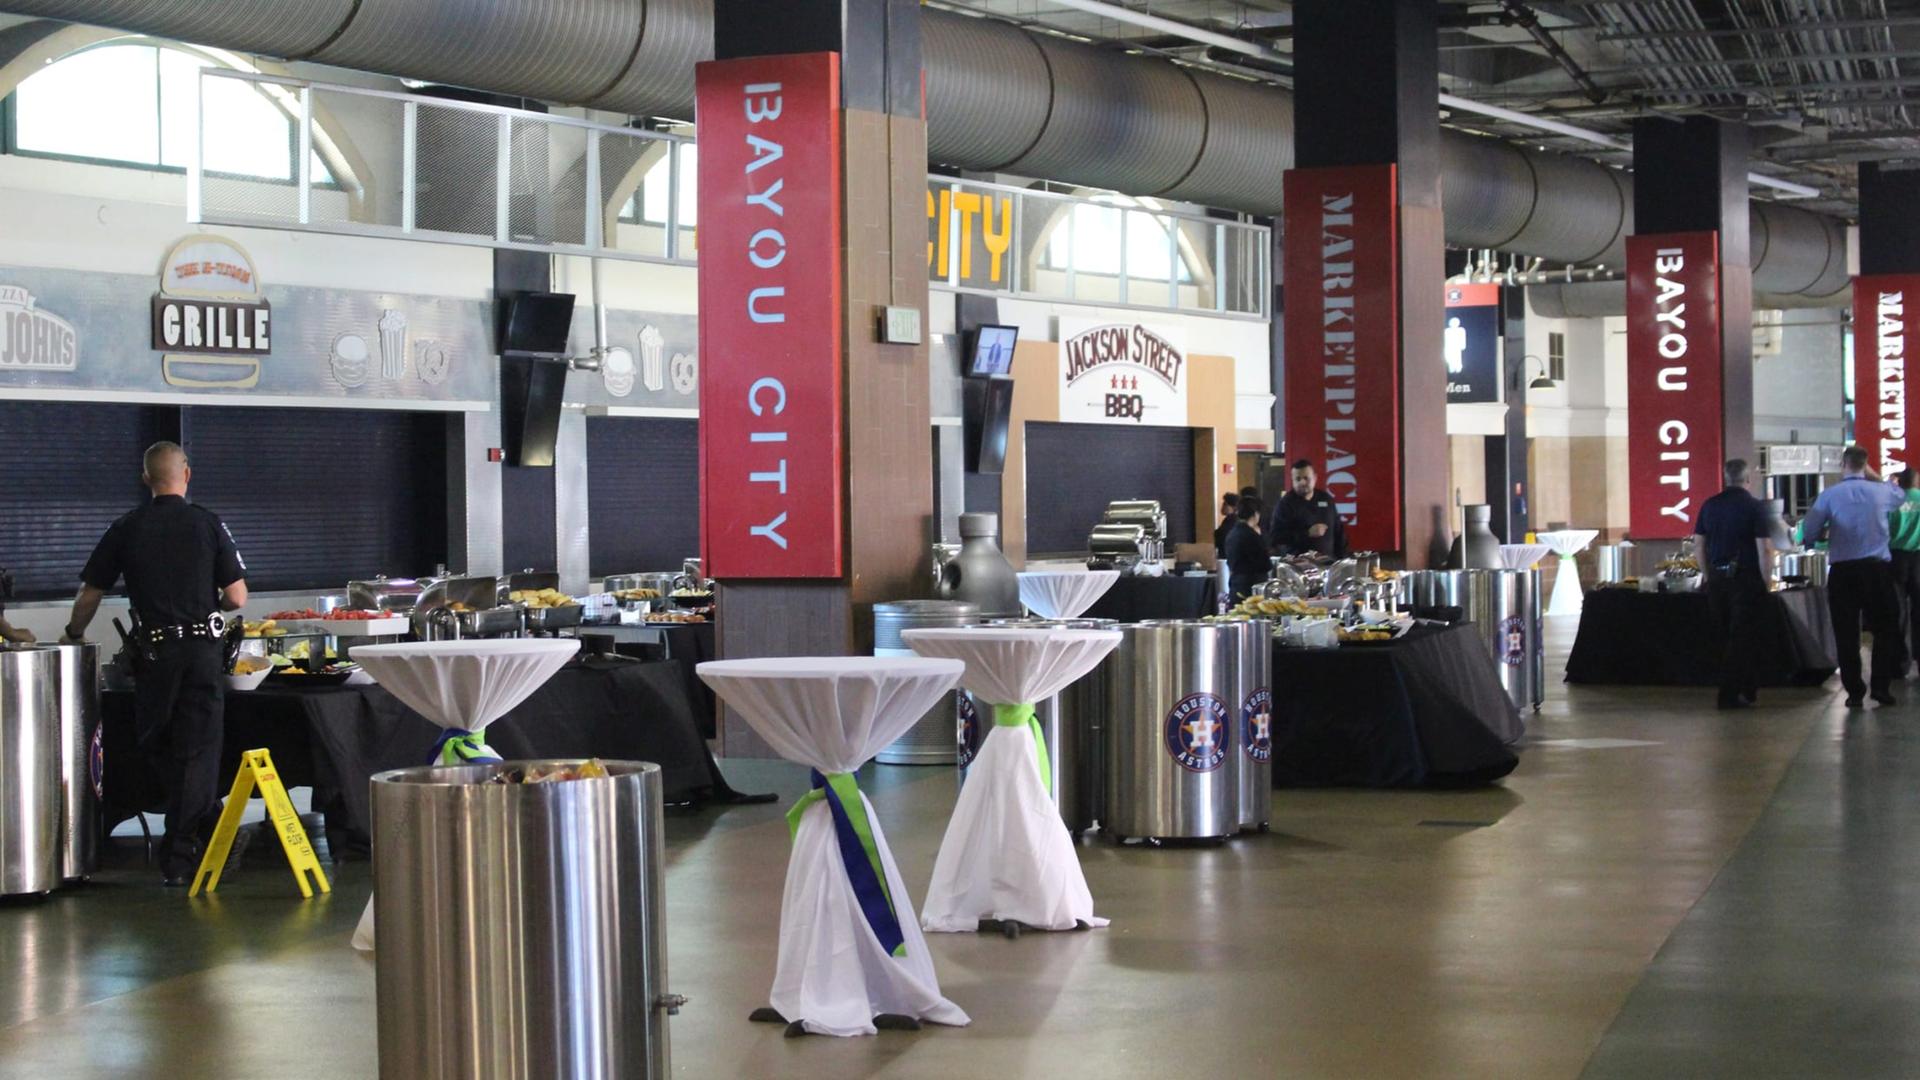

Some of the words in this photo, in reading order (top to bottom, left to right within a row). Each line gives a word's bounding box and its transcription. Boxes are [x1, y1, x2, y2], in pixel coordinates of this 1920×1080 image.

[743, 82, 787, 324] BAYOU
[1, 311, 74, 366] JOHNS
[162, 304, 270, 350] GRILLE
[1655, 247, 1688, 393] BAYOU
[1065, 327, 1129, 382] JACKSON
[1132, 323, 1183, 387] STREET
[1322, 193, 1358, 527] MARKETPLACE
[1105, 393, 1144, 421] BBQ
[747, 376, 788, 552] CITY
[1659, 419, 1690, 523] CITY
[1174, 697, 1226, 720] HOUSTON
[1190, 720, 1216, 748] H
[1177, 748, 1225, 769] ASTROS
